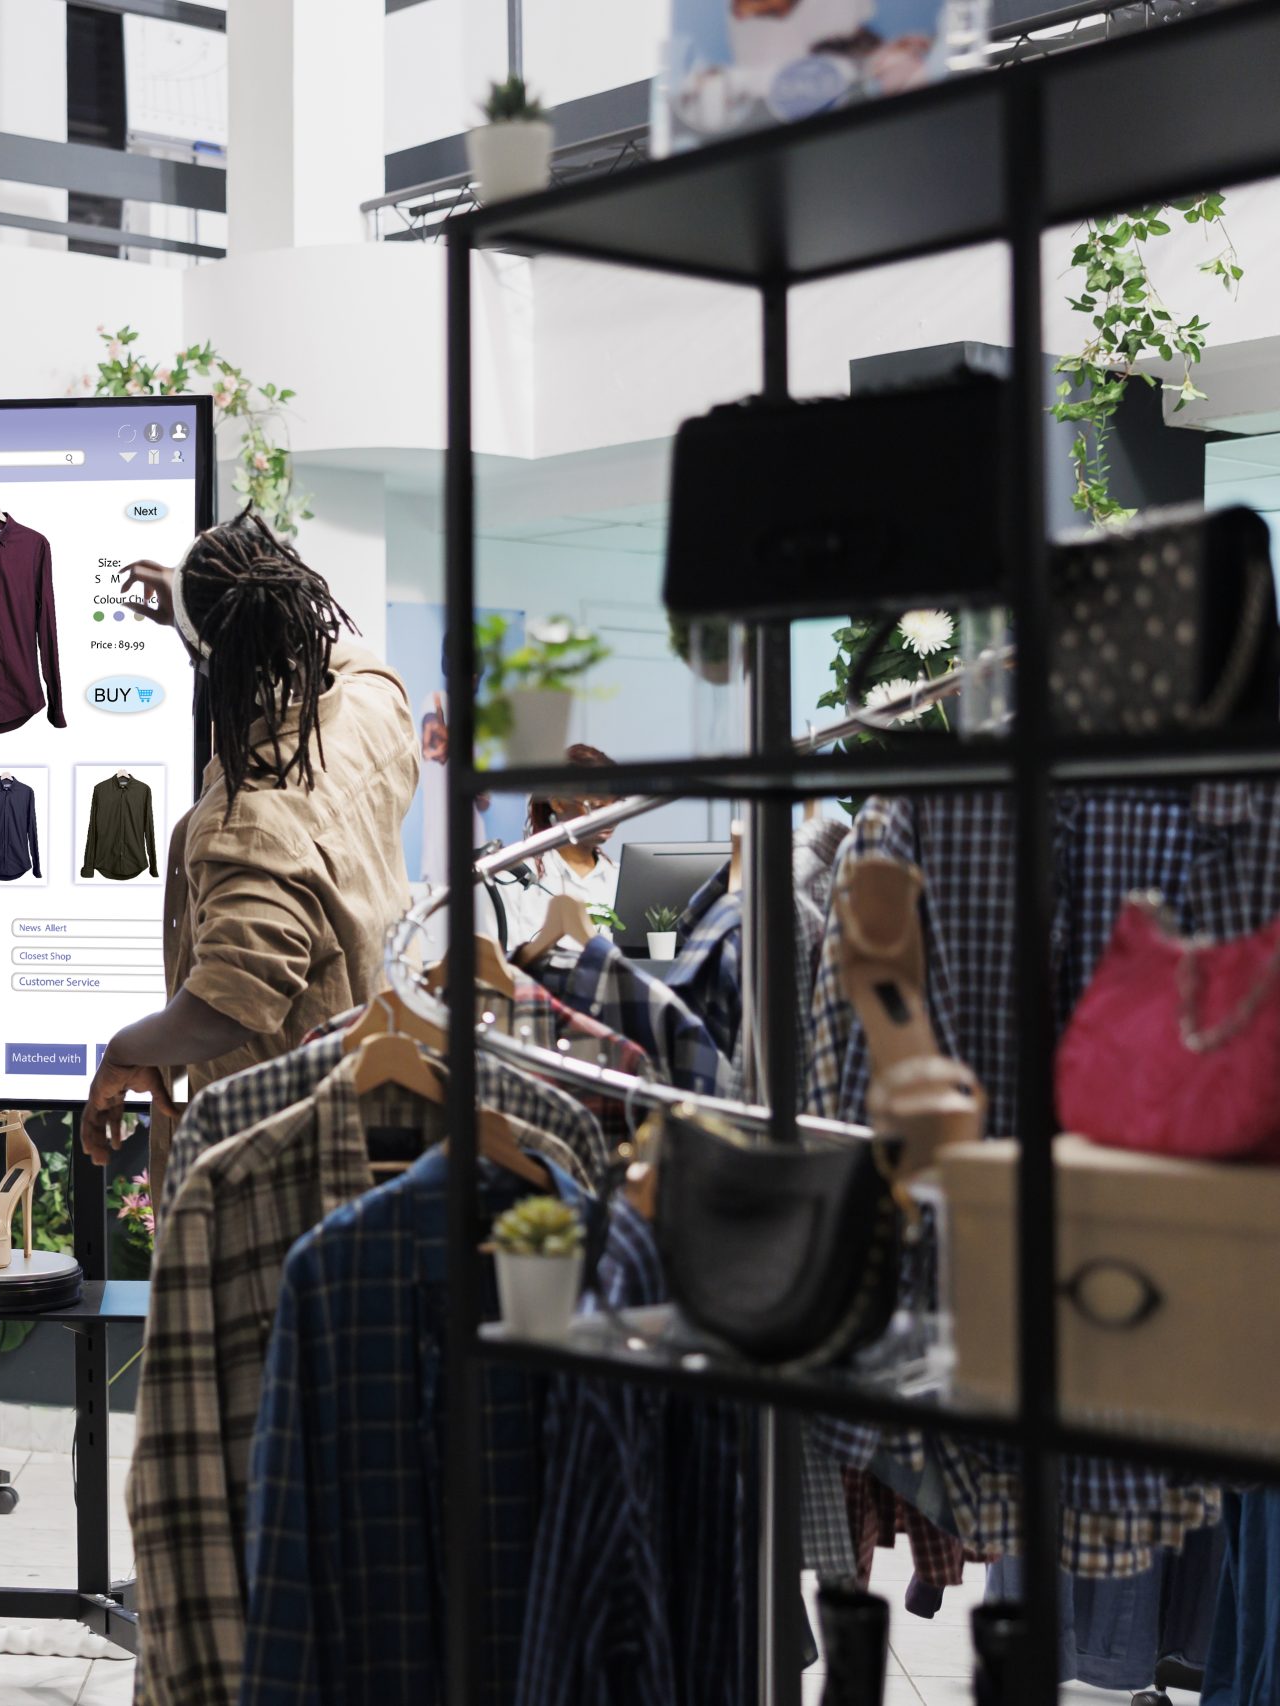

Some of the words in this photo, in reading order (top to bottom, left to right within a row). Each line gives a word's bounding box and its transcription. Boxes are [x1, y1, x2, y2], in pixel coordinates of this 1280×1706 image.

[134, 506, 158, 516] Next
[98, 558, 121, 568] Size:
[94, 574, 101, 584] S
[110, 574, 121, 584] M
[93, 595, 126, 605] Colour
[90, 640, 113, 650] Price
[118, 640, 145, 651] 89.99
[94, 687, 132, 703] BUY
[19, 923, 42, 932] News
[45, 923, 67, 932] Allert
[19, 951, 49, 961] Closest
[50, 952, 72, 962] Shop
[19, 976, 65, 987] Customer
[66, 977, 100, 987] Service
[12, 1052, 56, 1063] Matched
[58, 1053, 81, 1064] with
